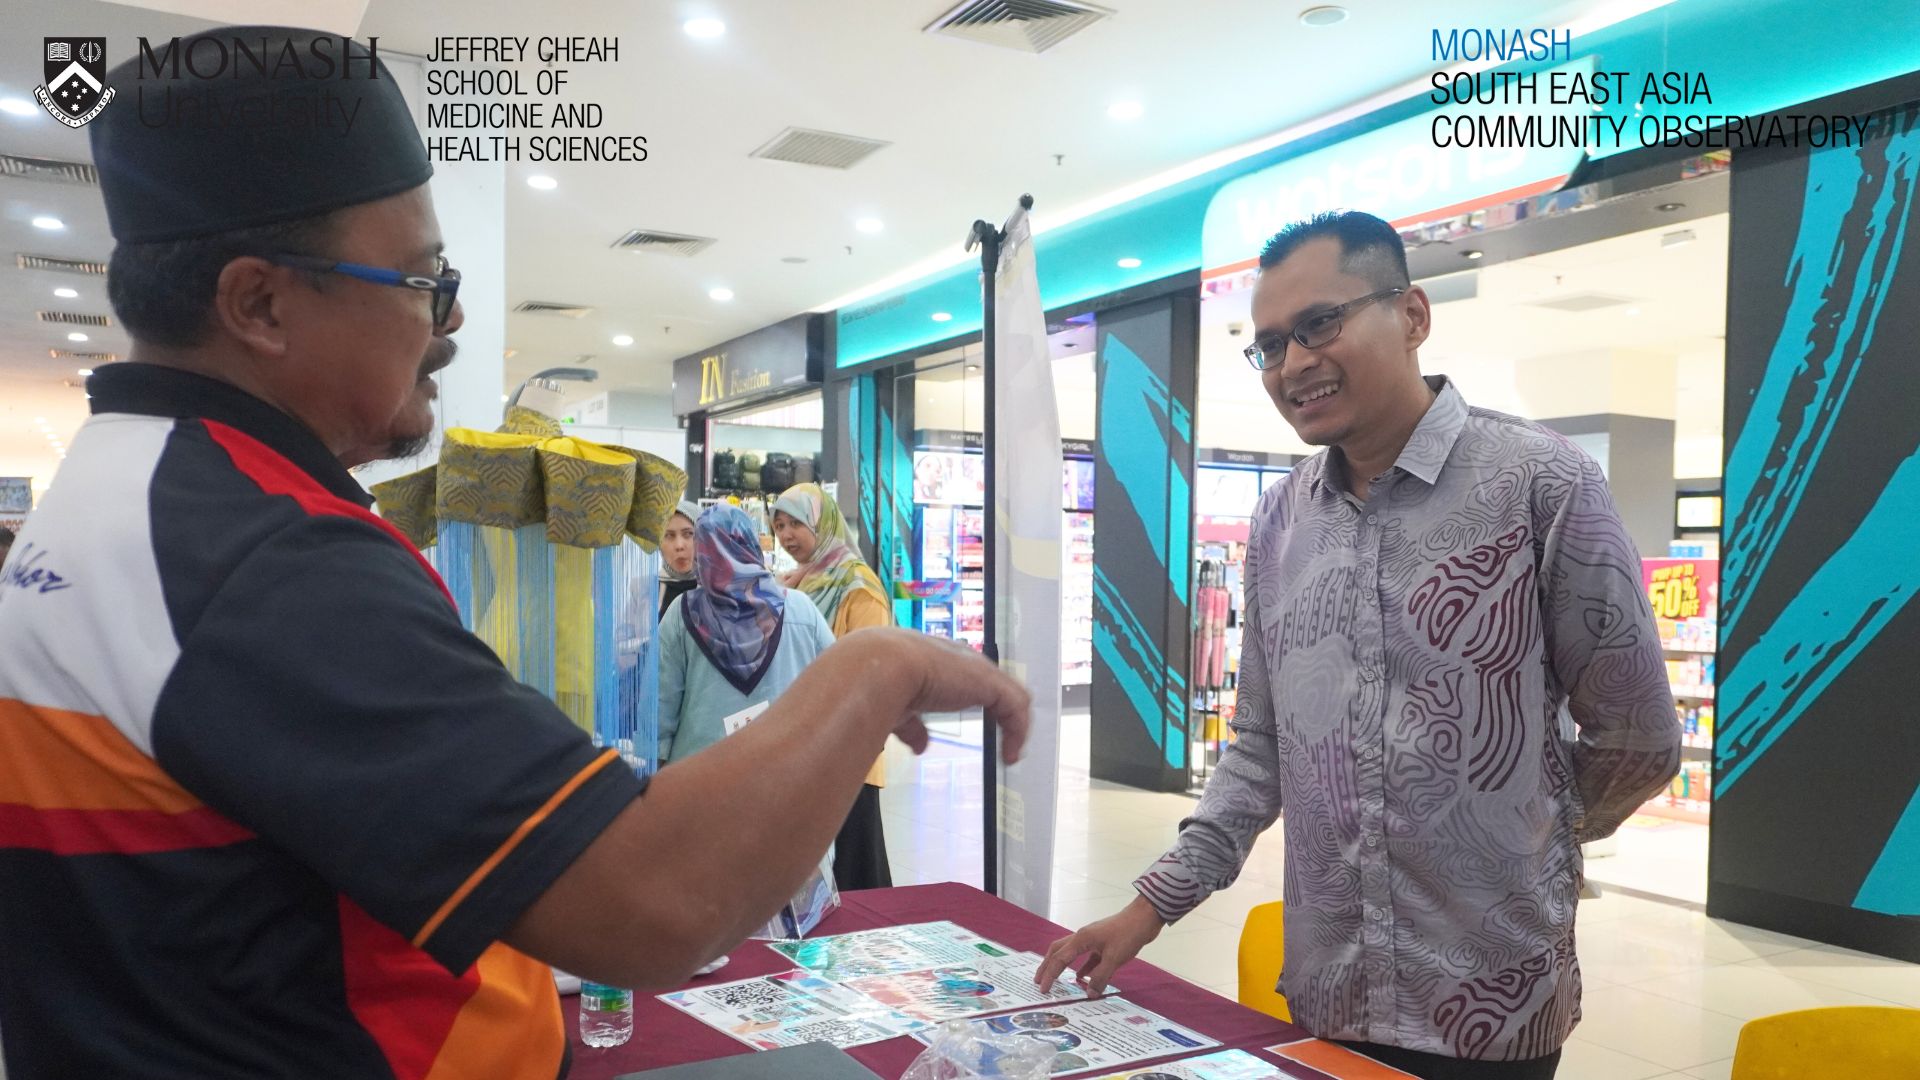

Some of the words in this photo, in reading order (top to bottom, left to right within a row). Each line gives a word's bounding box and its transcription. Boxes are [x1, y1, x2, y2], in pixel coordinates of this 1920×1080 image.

[699, 353, 728, 404] IN
[1649, 576, 1699, 618] 50%
[1680, 599, 1699, 617] OFF
